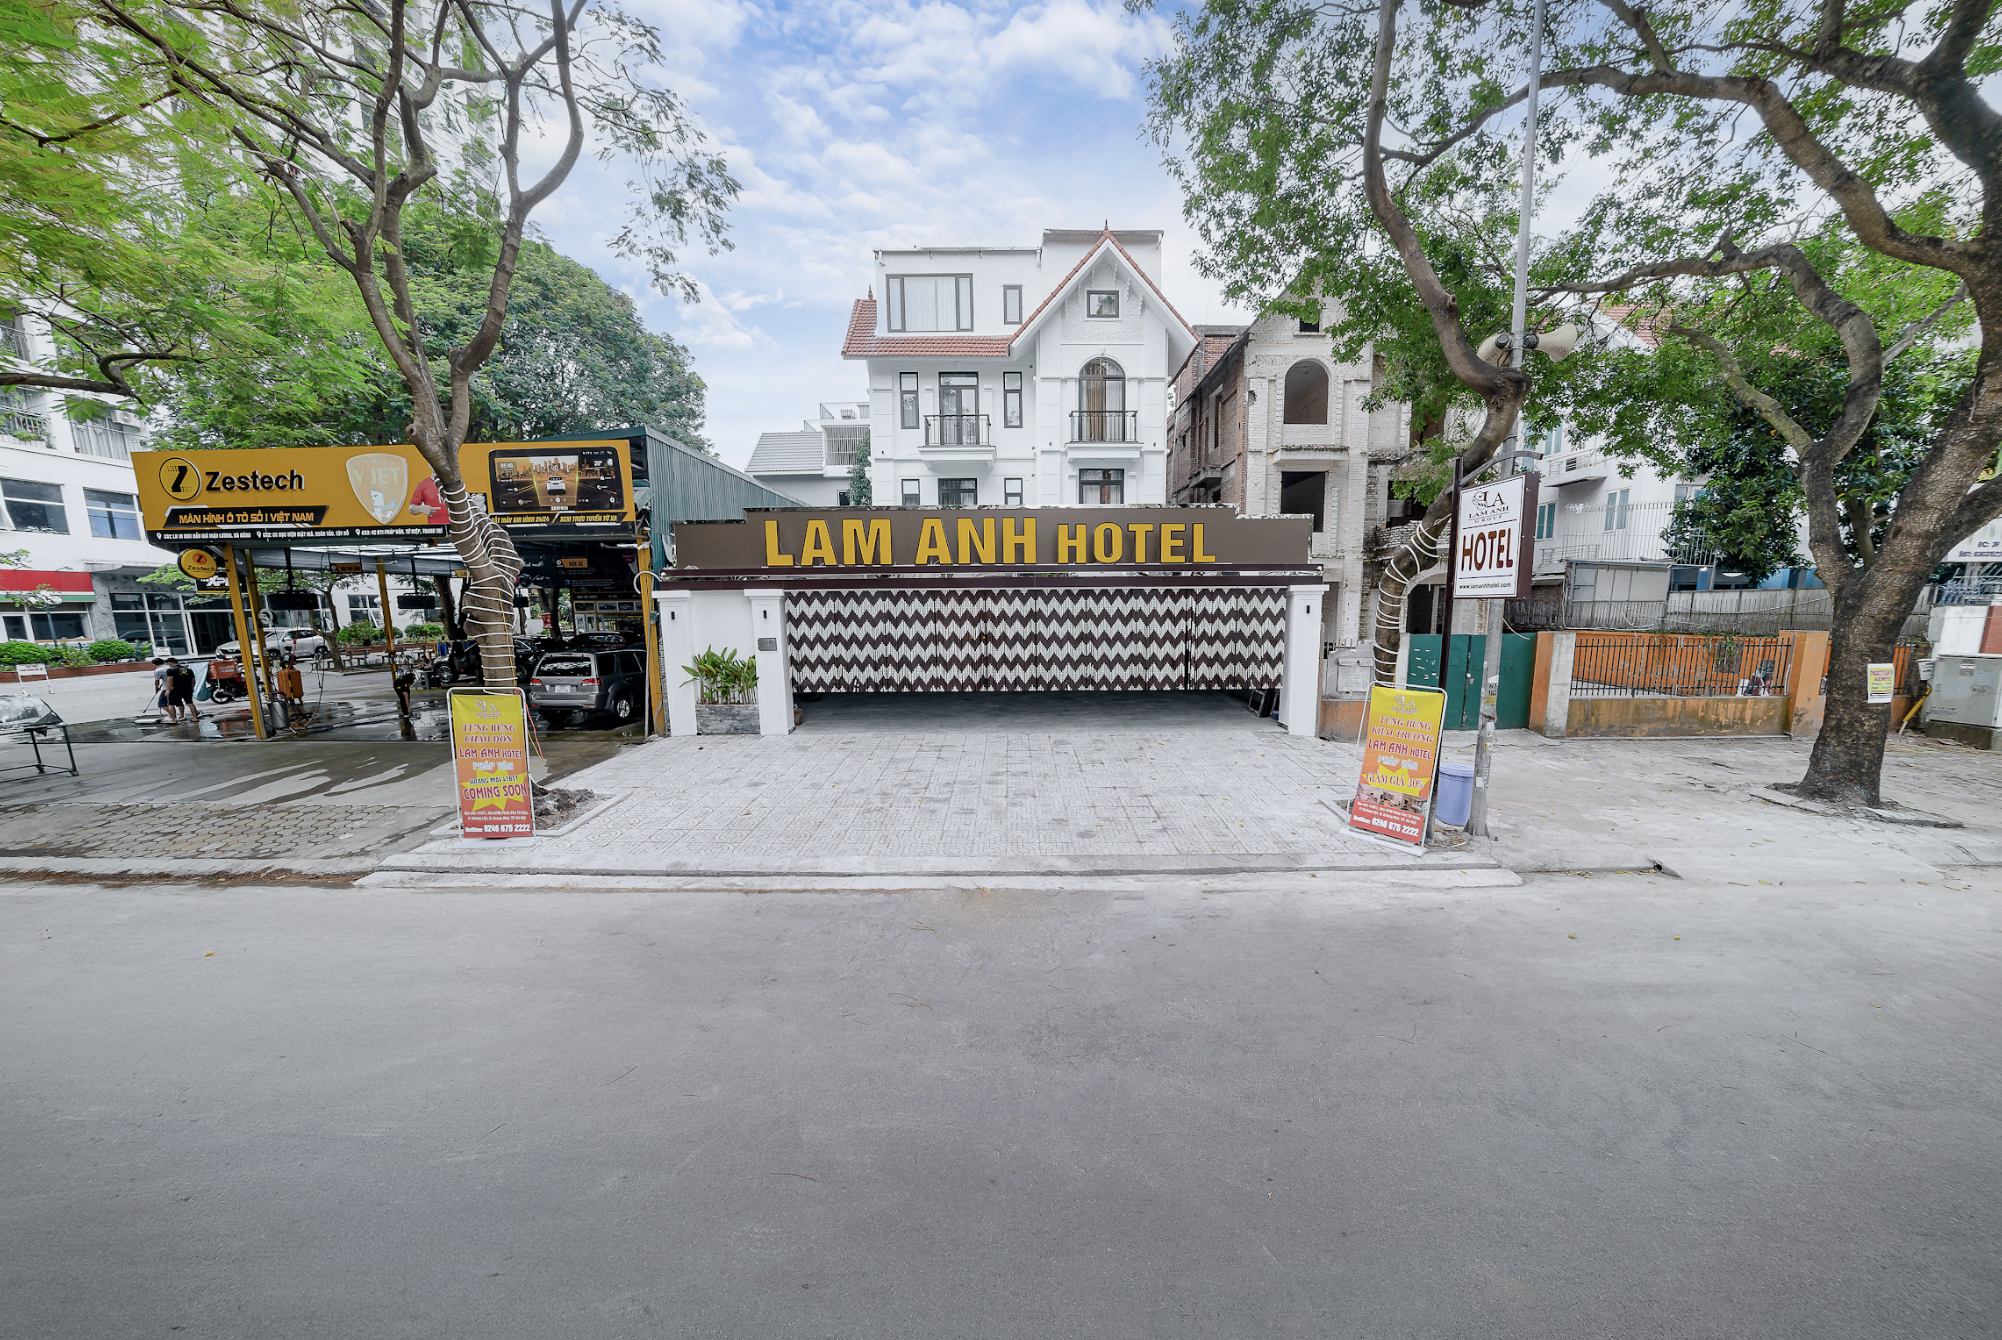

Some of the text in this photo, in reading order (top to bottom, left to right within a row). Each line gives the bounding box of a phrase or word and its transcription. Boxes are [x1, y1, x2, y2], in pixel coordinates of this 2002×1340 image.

[205, 469, 304, 492] Zestech
[353, 468, 400, 485] V-JET
[179, 513, 201, 524] MÀN
[203, 513, 224, 523] HÌNH
[226, 511, 234, 522] Ô
[236, 511, 248, 522] TÔ
[250, 510, 264, 522] SỐ
[270, 511, 290, 524] VIỆT
[292, 513, 314, 522] NAM
[1469, 506, 1509, 520] LAM ANH
[764, 517, 1216, 566] LAM ANH HOTEL
[1461, 527, 1513, 572] HOTEL
[187, 564, 215, 572] Zestech
[1459, 581, 1511, 590] www.lamanhhotel.com
[1380, 716, 1404, 727] TƯNG
[464, 733, 513, 743] CHÀO ĐÓN
[1371, 726, 1393, 738] KHAI
[458, 748, 523, 759] LAM ANH HOTEL
[1368, 738, 1431, 760] LAM ANH HOTEL
[1365, 770, 1424, 790] GIẢM GIÁ 30%
[463, 783, 528, 800] COMING SOON
[514, 824, 531, 832] 2222
[1401, 825, 1419, 837] 2222
